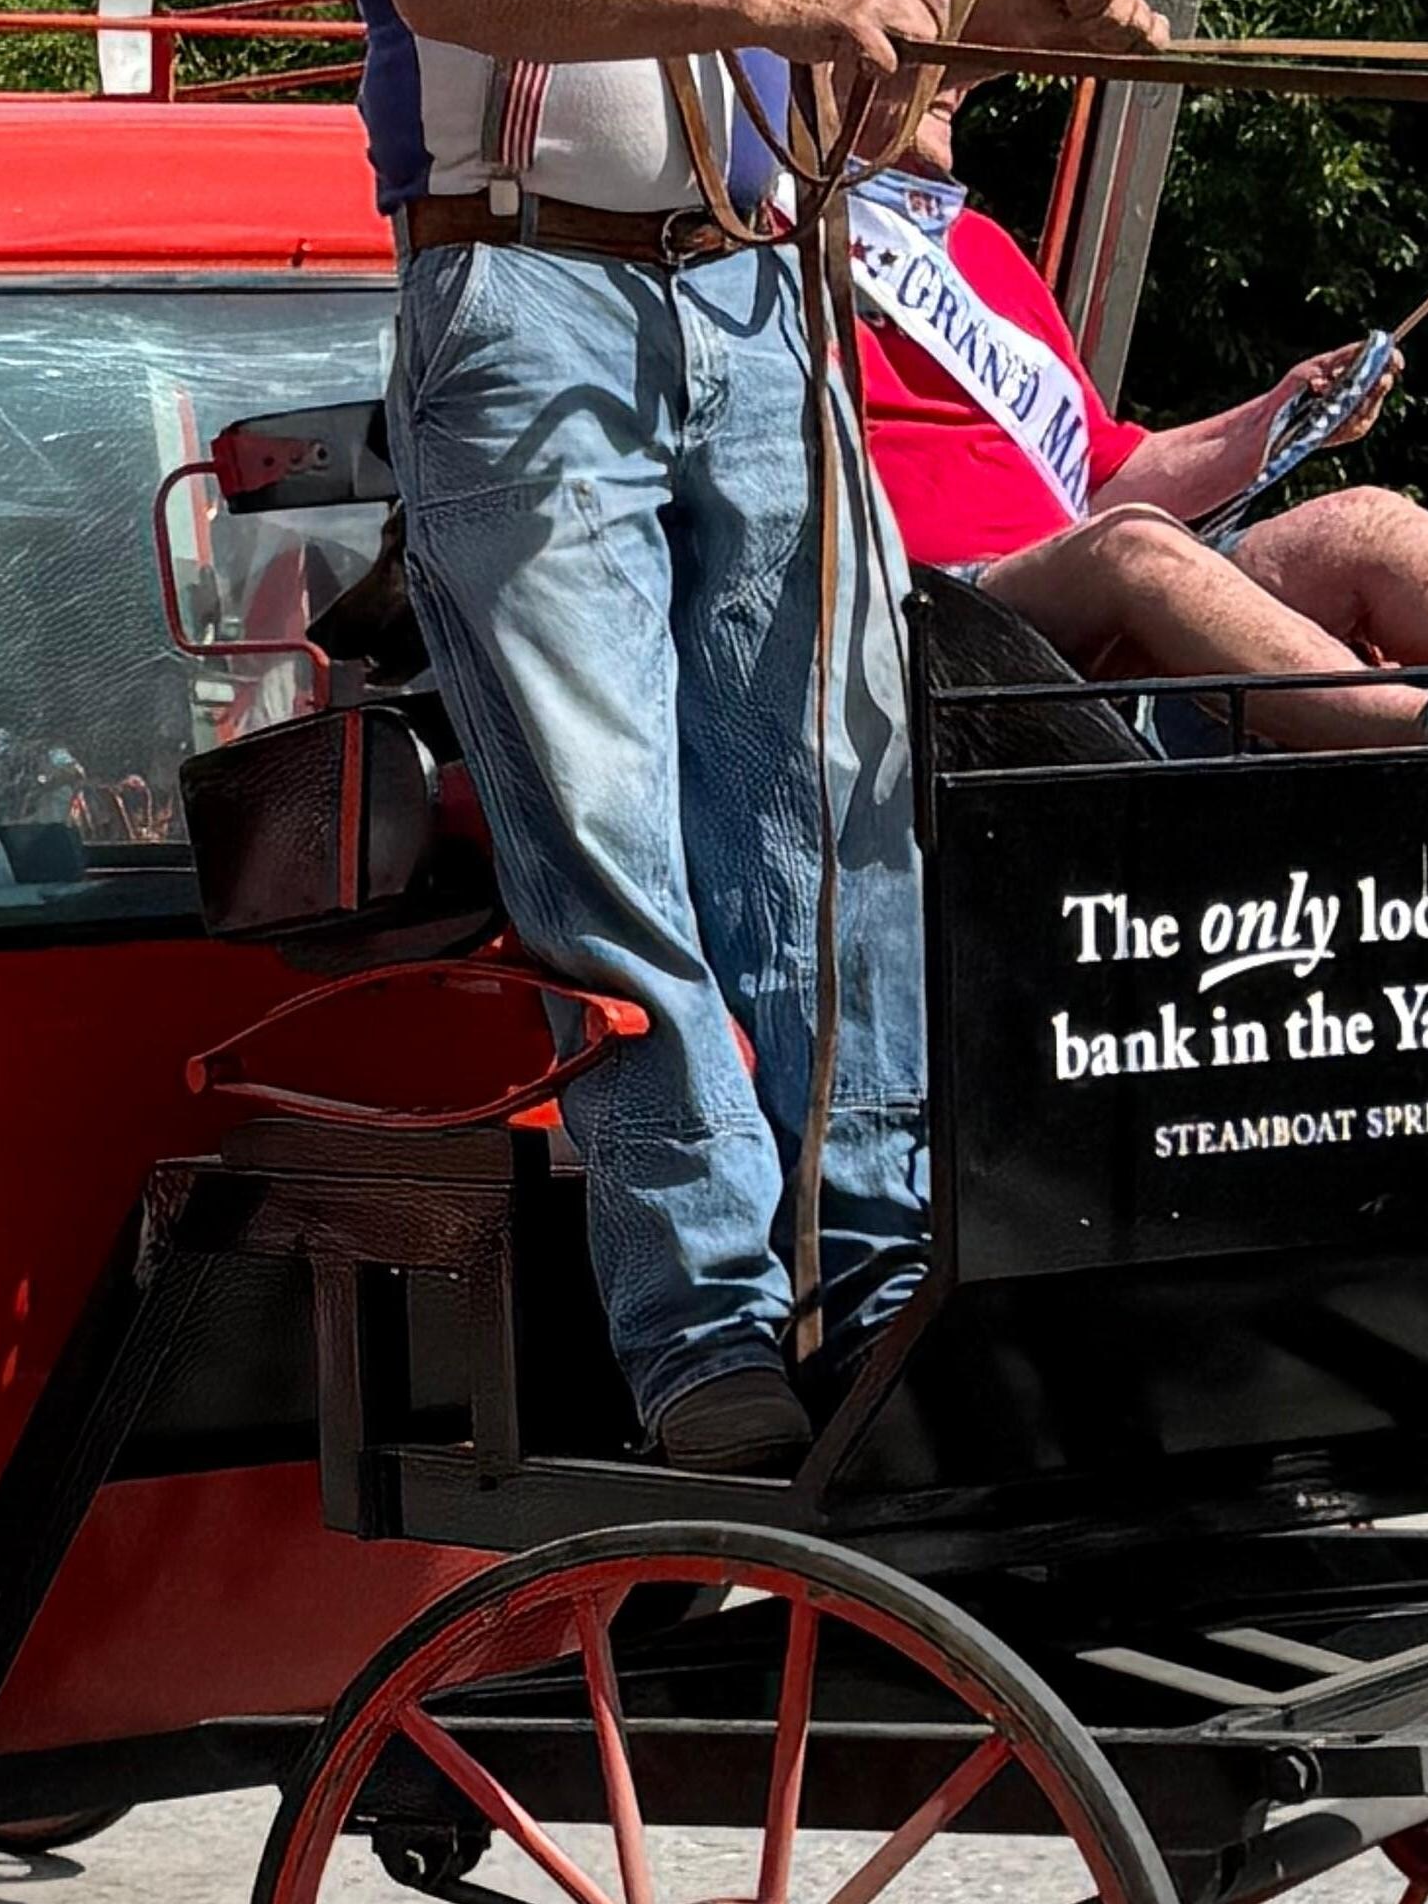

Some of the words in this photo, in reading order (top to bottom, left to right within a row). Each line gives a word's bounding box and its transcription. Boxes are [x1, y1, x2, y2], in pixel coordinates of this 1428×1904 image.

[897, 254, 1041, 423] GRAND
[1039, 395, 1090, 516] MA
[1062, 893, 1180, 963] The
[1199, 870, 1341, 980] only
[1052, 1002, 1200, 1080] bank
[1210, 1006, 1270, 1066] in
[1284, 991, 1375, 1060] the
[1155, 1108, 1357, 1159] STEAMBOAT
